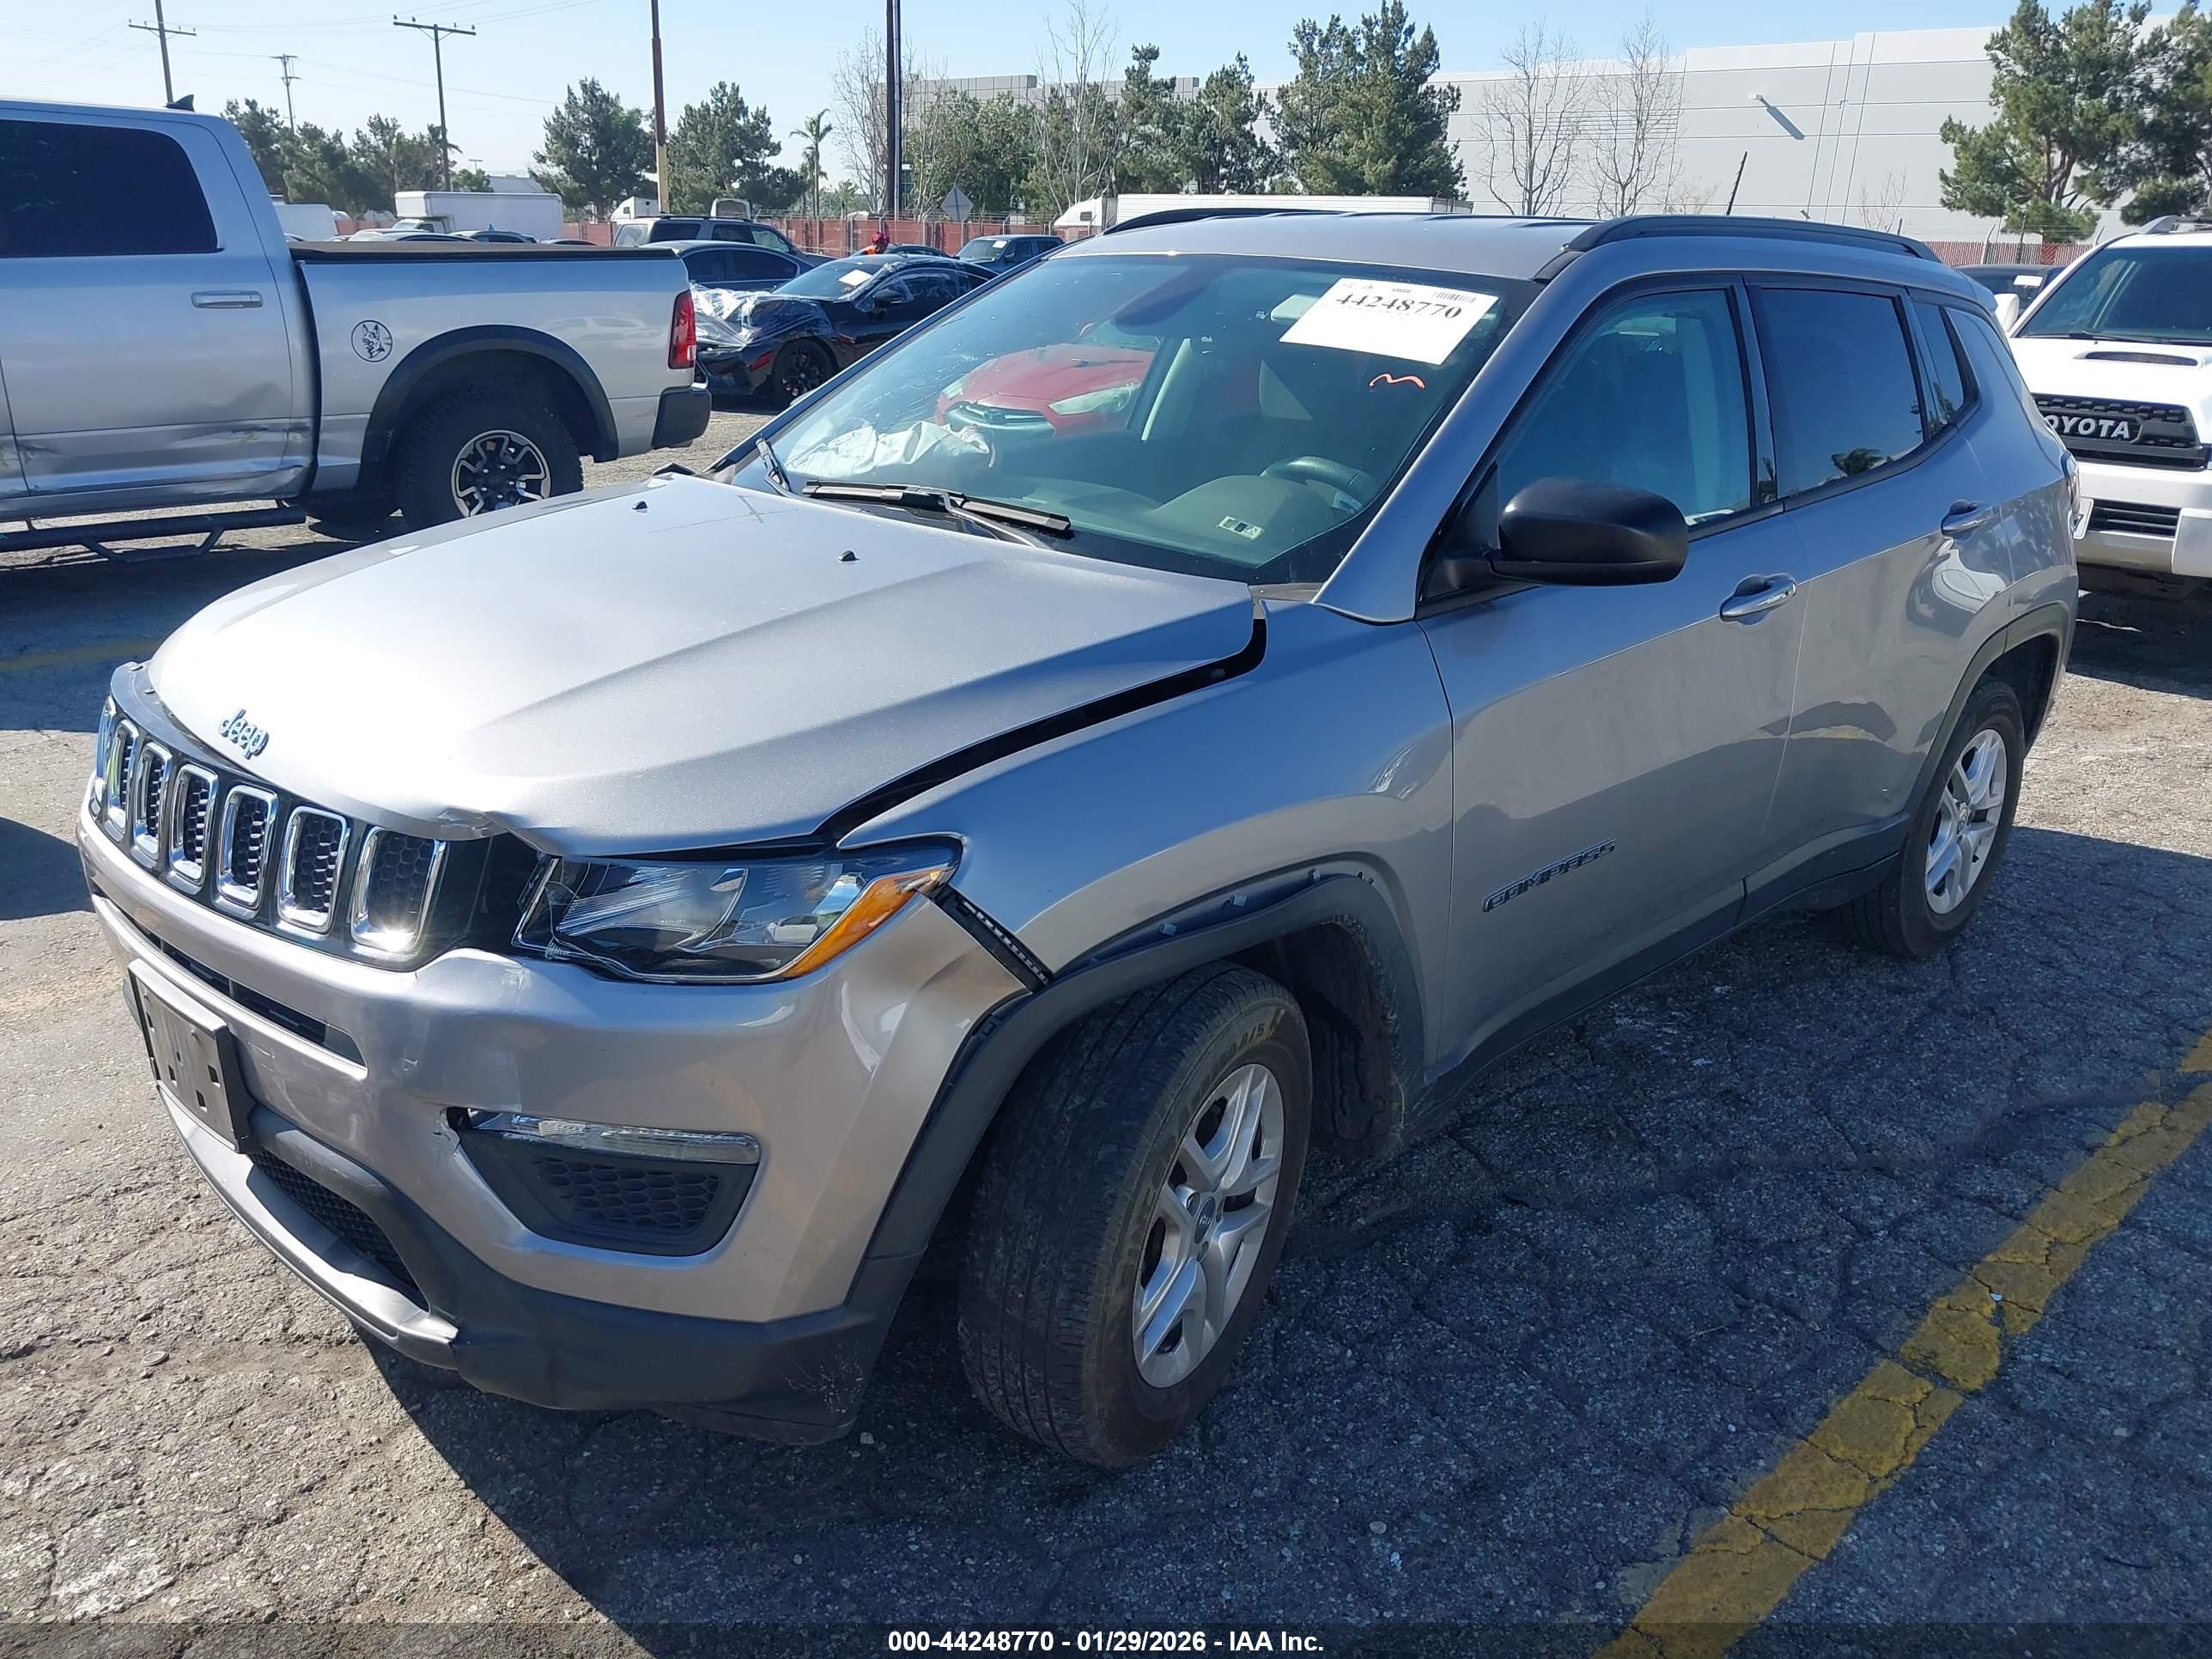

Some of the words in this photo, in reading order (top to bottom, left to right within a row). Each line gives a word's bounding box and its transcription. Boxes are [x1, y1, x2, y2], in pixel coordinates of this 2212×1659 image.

[1335, 293, 1462, 319] 44248770
[2044, 414, 2130, 440] OYOTA
[219, 708, 270, 760] Jeep
[1483, 838, 1615, 913] COMPASS
